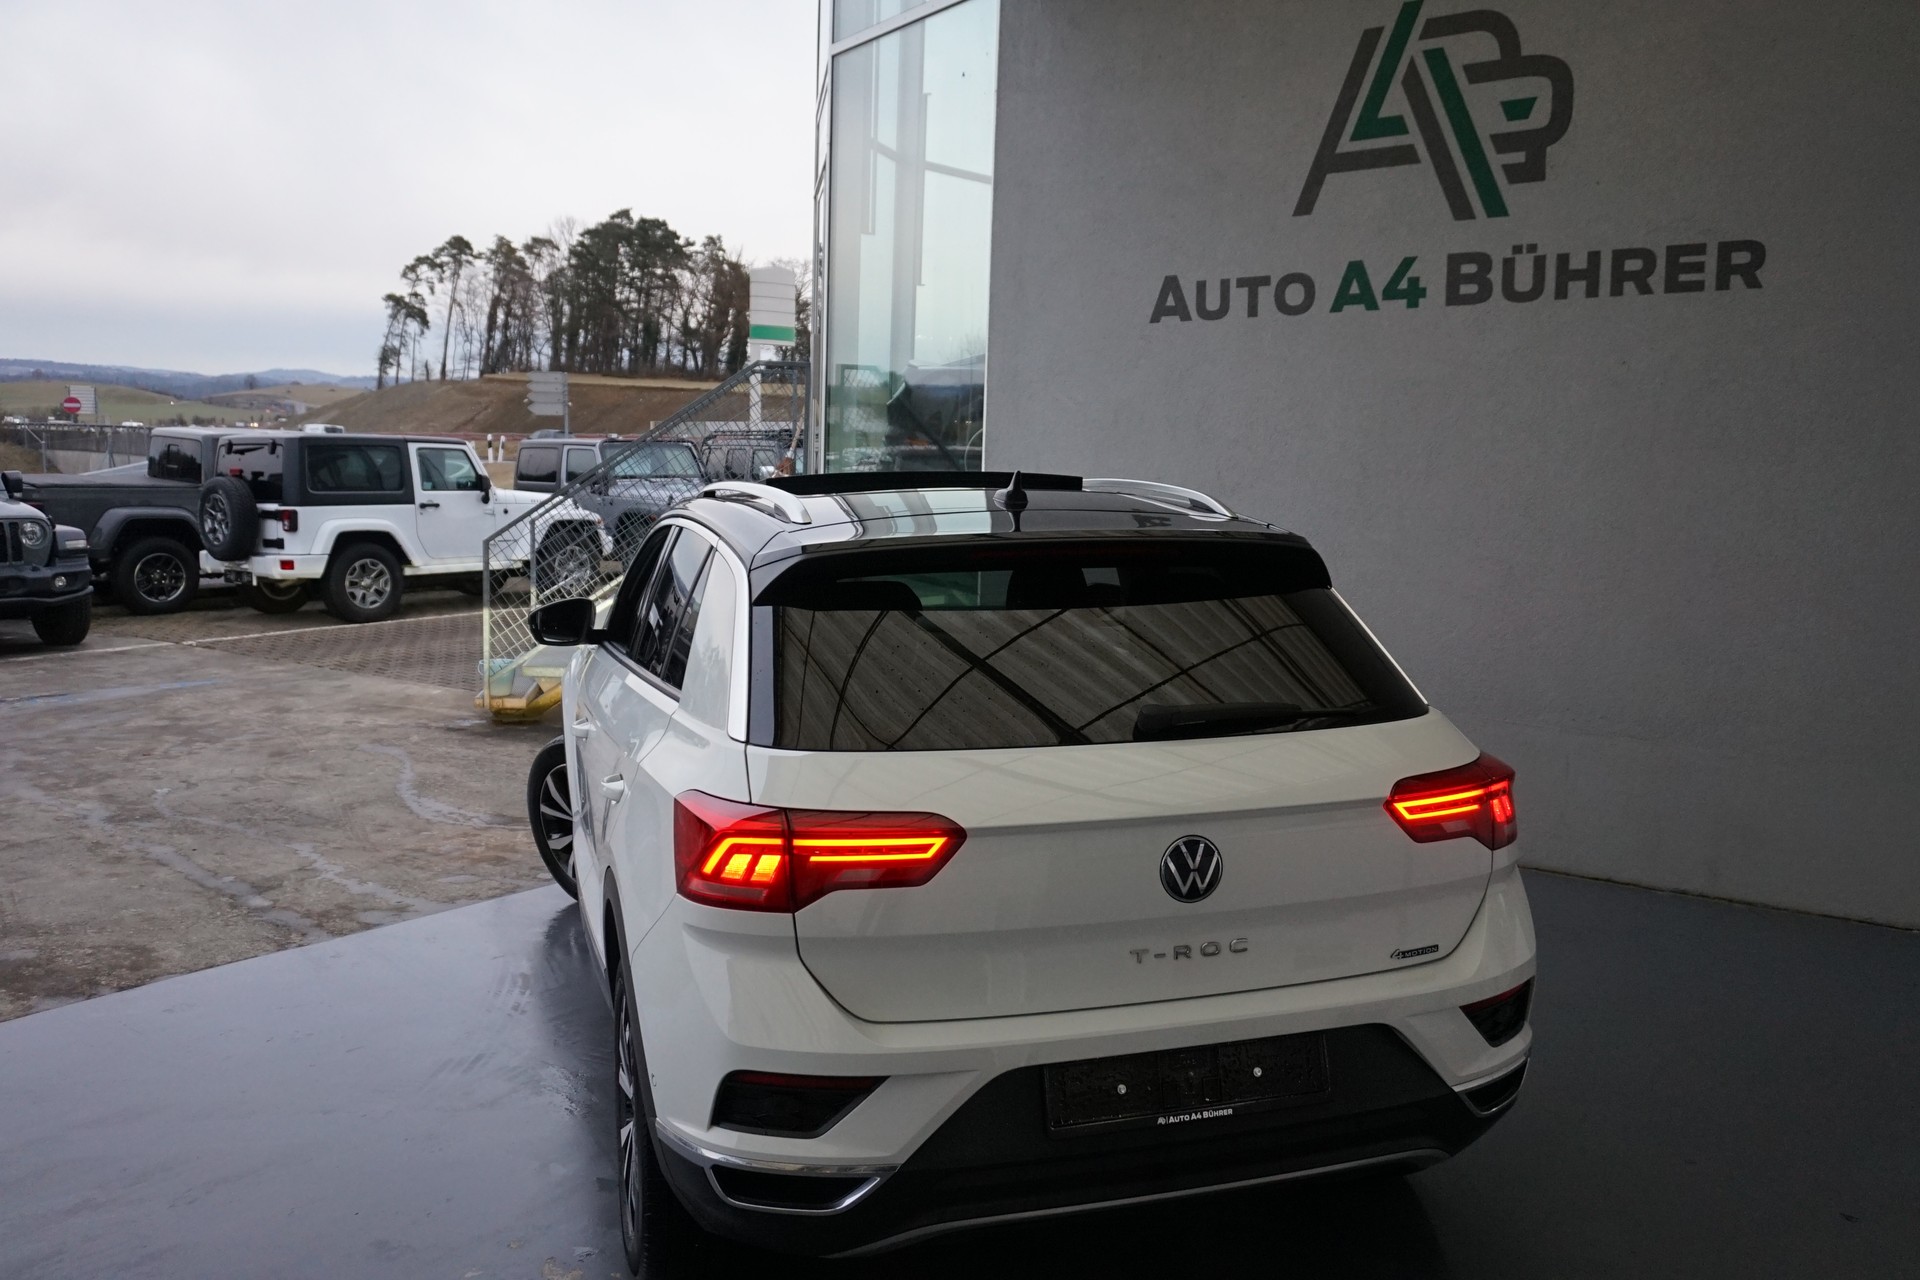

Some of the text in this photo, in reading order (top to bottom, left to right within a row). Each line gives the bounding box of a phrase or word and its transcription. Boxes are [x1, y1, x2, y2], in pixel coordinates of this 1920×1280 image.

[1149, 239, 1766, 323] AUTO A4 BÜHRER
[1163, 837, 1220, 900] VW
[1129, 937, 1248, 964] T-ROC
[1169, 1115, 1190, 1123] AUTO
[1191, 1112, 1202, 1120] A4
[1203, 1108, 1233, 1118] BÜHRER
